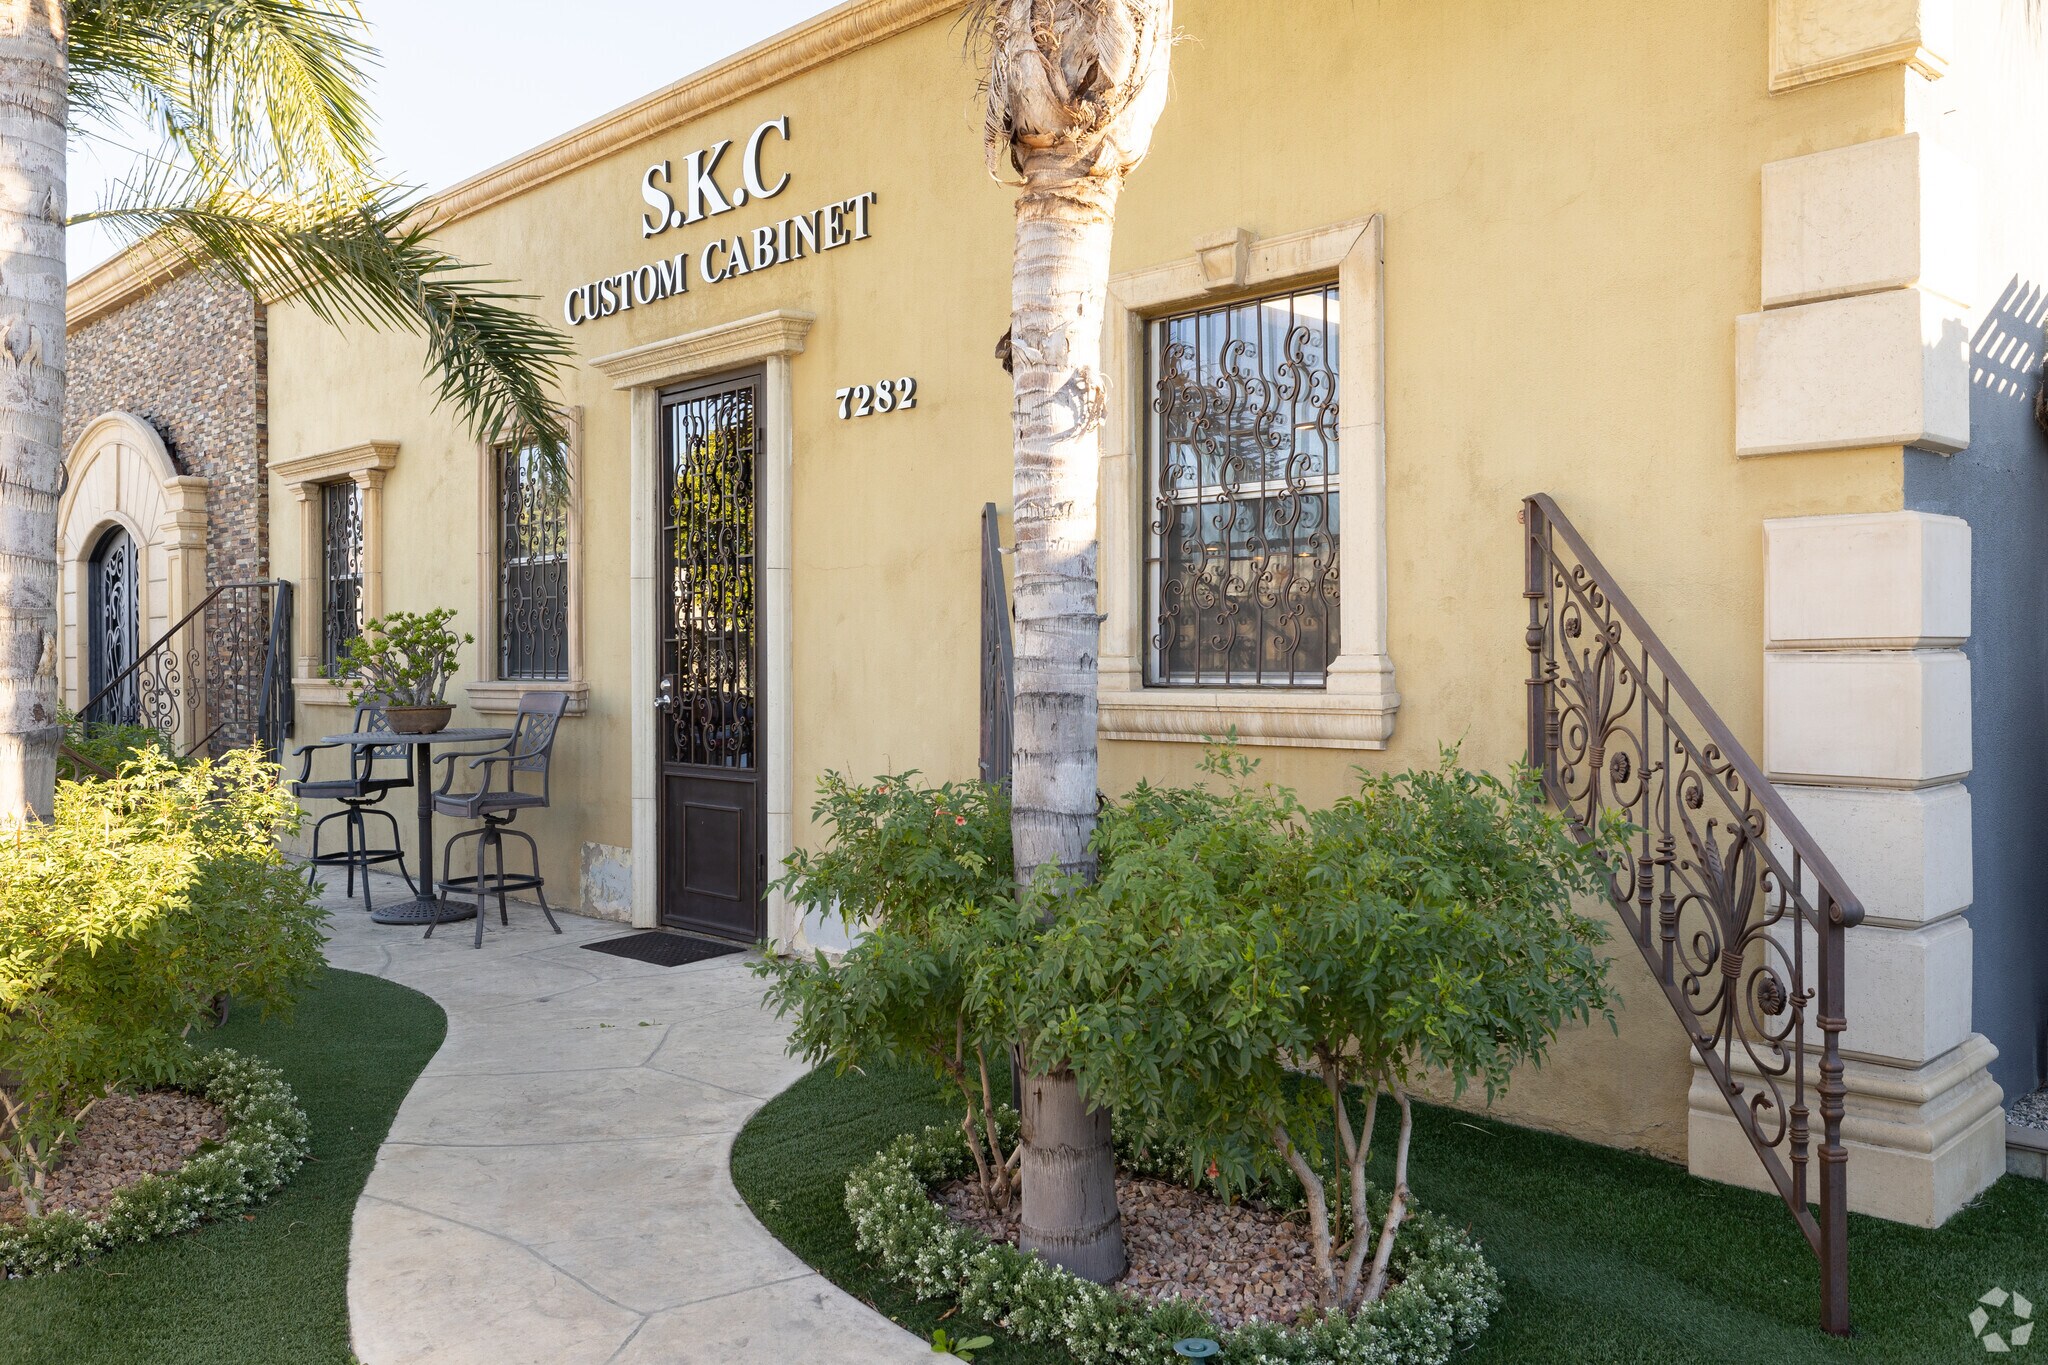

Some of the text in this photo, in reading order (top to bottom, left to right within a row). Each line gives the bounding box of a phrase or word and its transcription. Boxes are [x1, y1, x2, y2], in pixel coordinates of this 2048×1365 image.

[641, 114, 791, 238] S.K.C
[564, 191, 877, 325] CUSTOM CABINET
[835, 376, 917, 419] 7282
